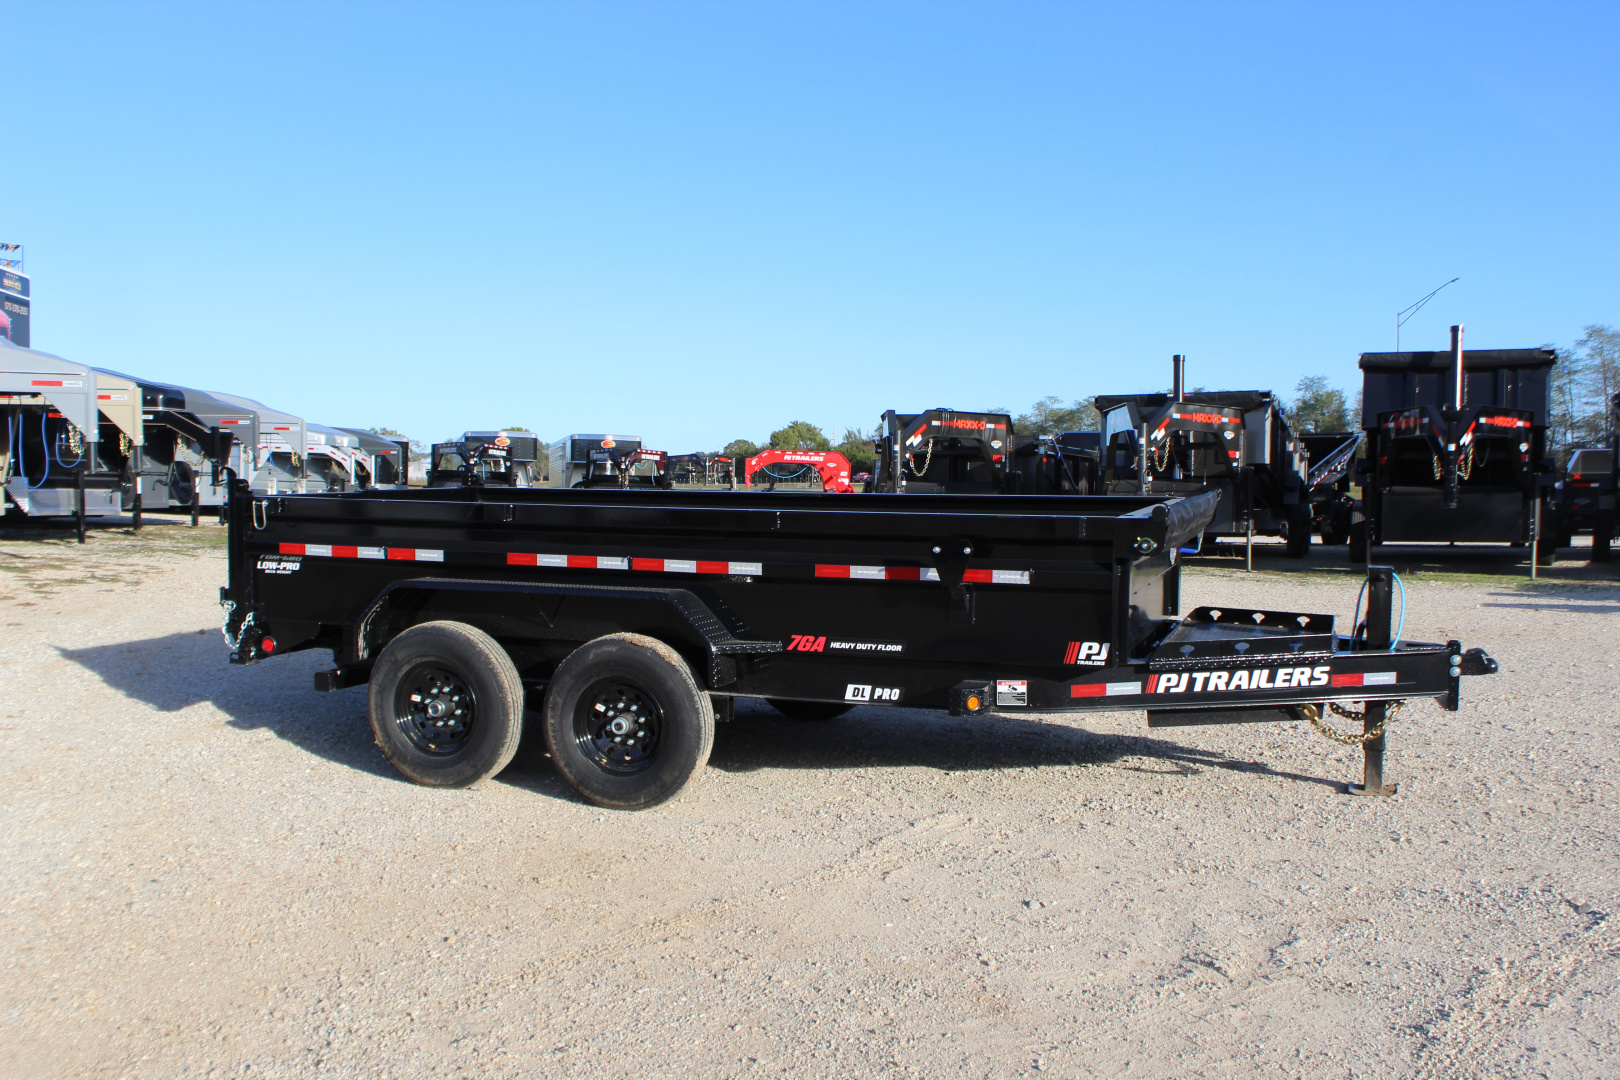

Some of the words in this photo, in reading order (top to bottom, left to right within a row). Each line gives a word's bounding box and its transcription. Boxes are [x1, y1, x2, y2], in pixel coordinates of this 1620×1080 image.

[256, 560, 301, 571] LOW-PRO
[786, 634, 827, 653] 7GA
[830, 641, 856, 650] HEAVY
[856, 642, 877, 651] DUTY
[877, 644, 902, 652] FLOOR
[1078, 641, 1110, 660] PJ
[1156, 672, 1190, 694] PJ
[1191, 665, 1331, 692] TRAILERS
[851, 686, 867, 698] DL
[873, 687, 901, 701] PRO
